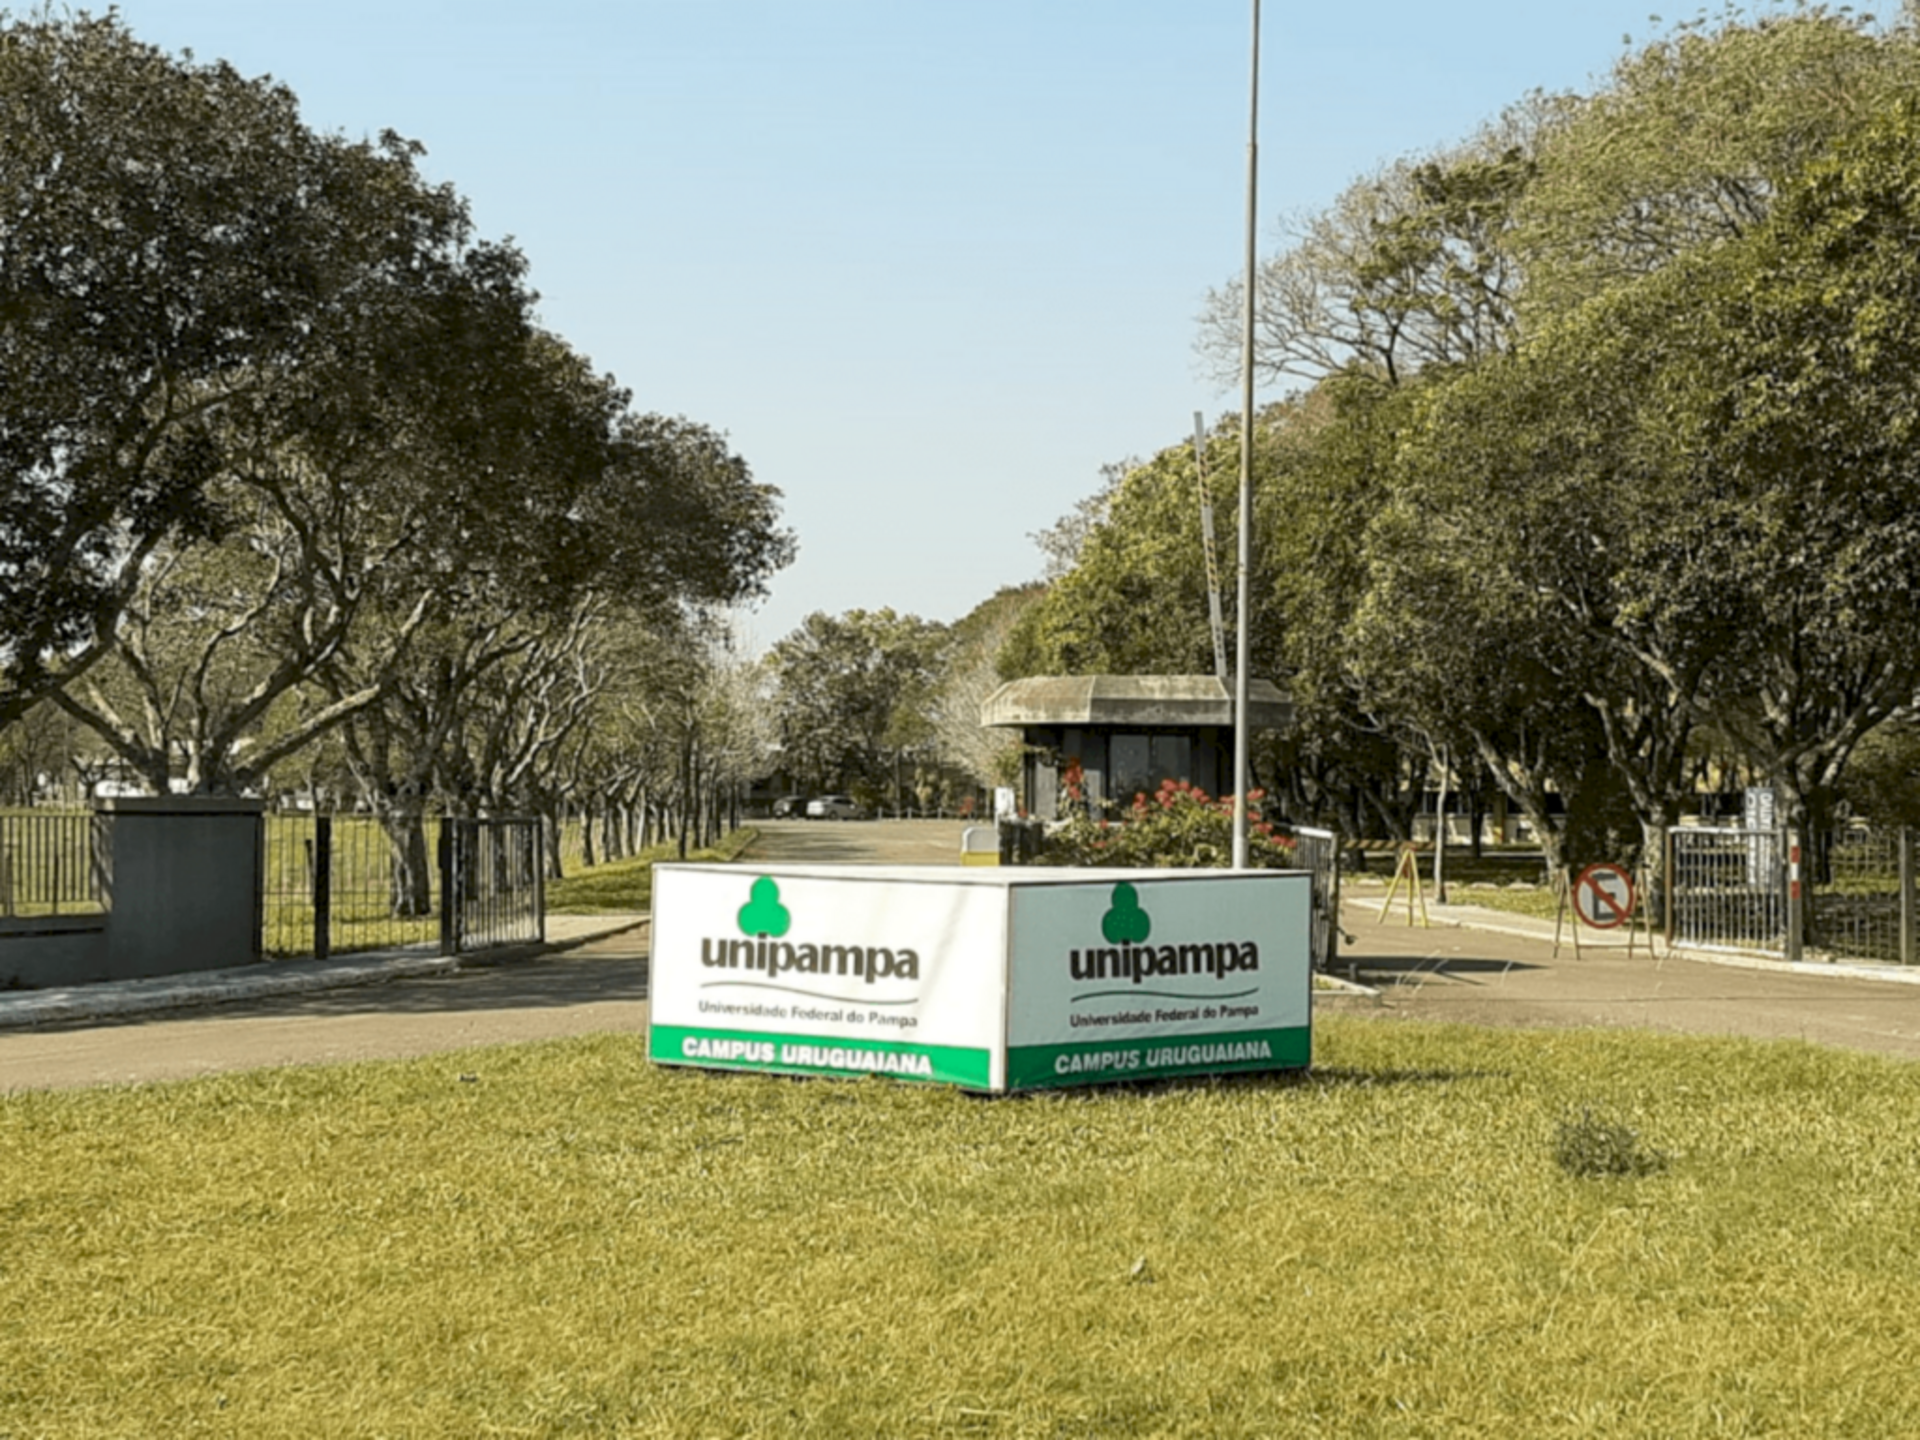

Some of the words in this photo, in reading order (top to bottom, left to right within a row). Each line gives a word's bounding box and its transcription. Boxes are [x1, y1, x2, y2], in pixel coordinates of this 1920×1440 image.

[701, 932, 920, 984] unipampa
[1070, 938, 1259, 984] unipampa
[698, 1000, 788, 1019] Universidade
[791, 1007, 843, 1022] Federal
[847, 1010, 865, 1023] do
[868, 1011, 919, 1029] Pampa
[1070, 1010, 1152, 1028] Universidade
[1155, 1006, 1199, 1023] Federal
[1202, 1005, 1217, 1019] do
[1220, 1004, 1259, 1019] Pampa
[681, 1036, 775, 1062] CAMPUS
[781, 1044, 934, 1076] URUGUAIANA
[1054, 1049, 1140, 1074] CAMPUS
[1145, 1040, 1273, 1068] URUGUAIANA
